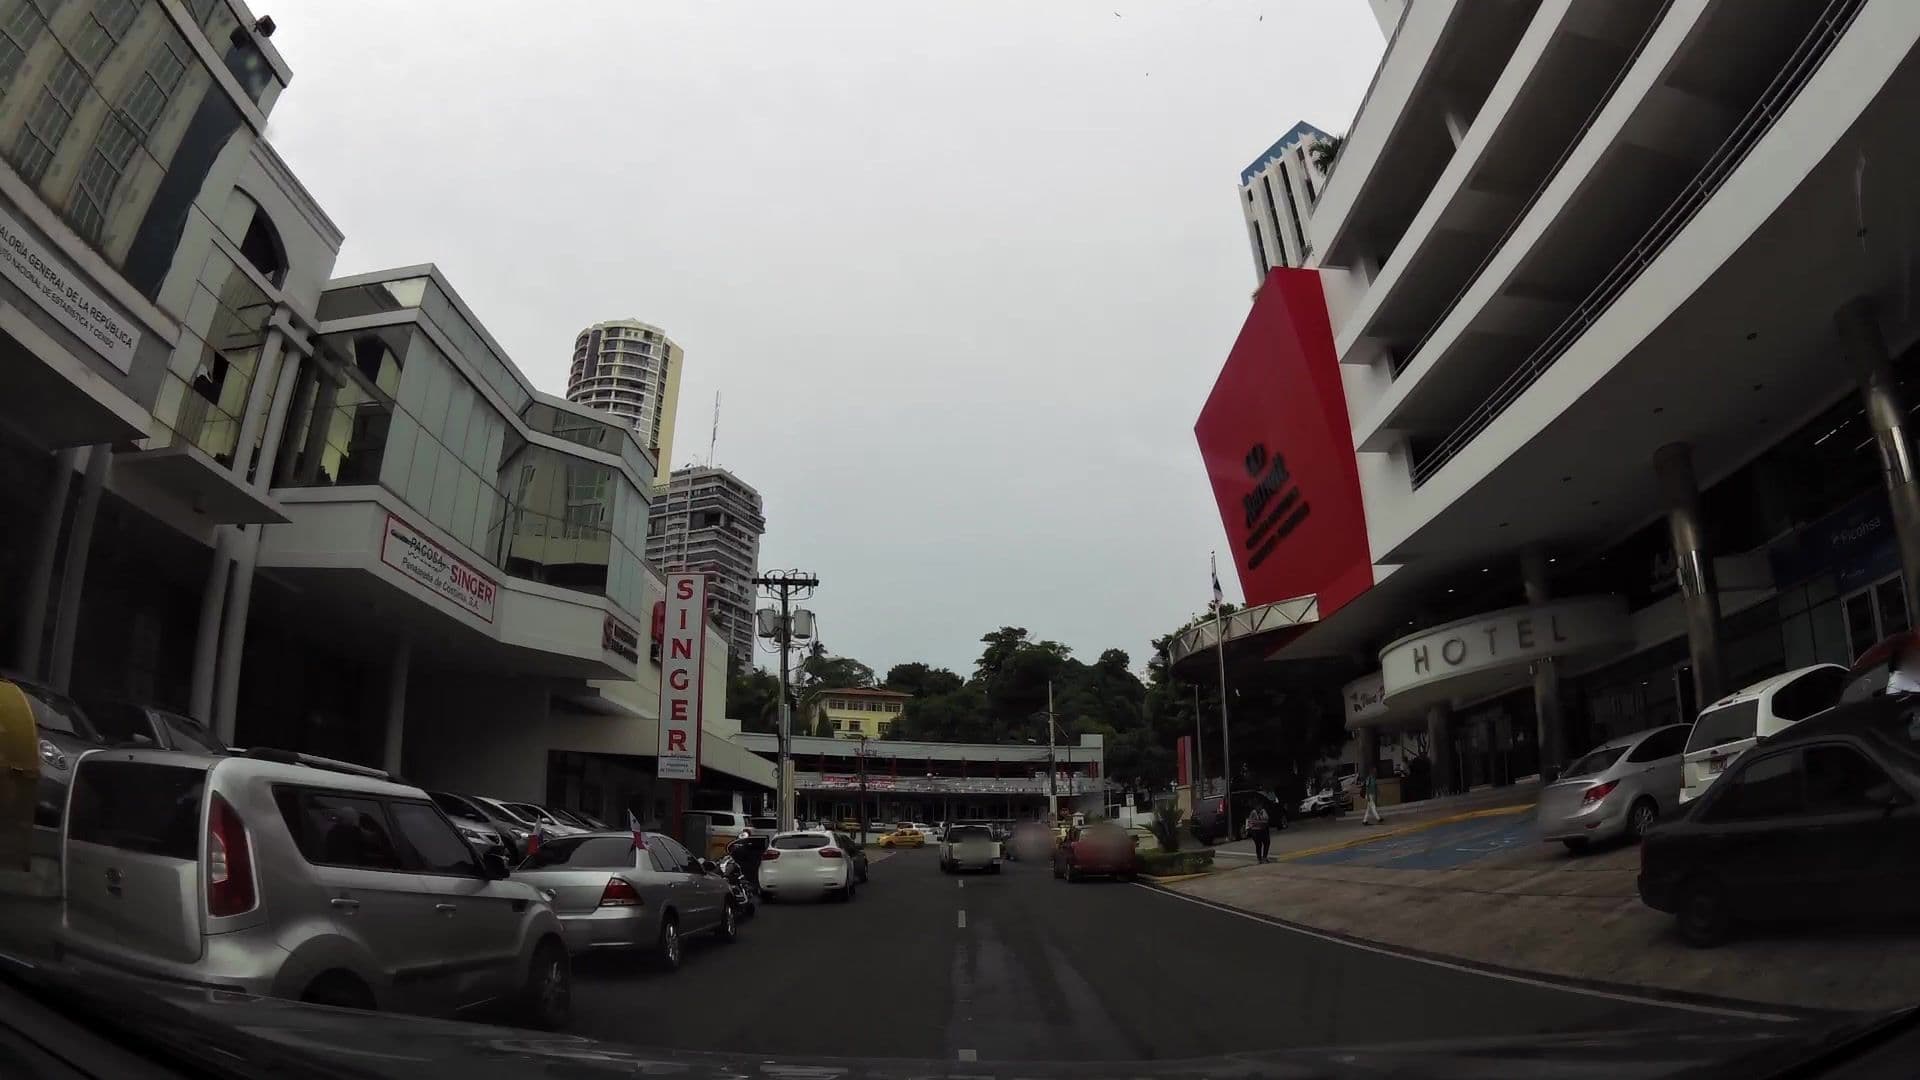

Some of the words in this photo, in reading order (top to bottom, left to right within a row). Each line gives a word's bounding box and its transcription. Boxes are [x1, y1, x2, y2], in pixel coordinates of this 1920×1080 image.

[28, 253, 66, 293] GENERAL
[66, 287, 80, 304] DE
[78, 297, 90, 313] LA
[89, 306, 133, 349] REPÚBLICA
[449, 564, 494, 605] SINGER
[668, 579, 694, 752] SINGER
[1413, 615, 1567, 674] HOTEL
